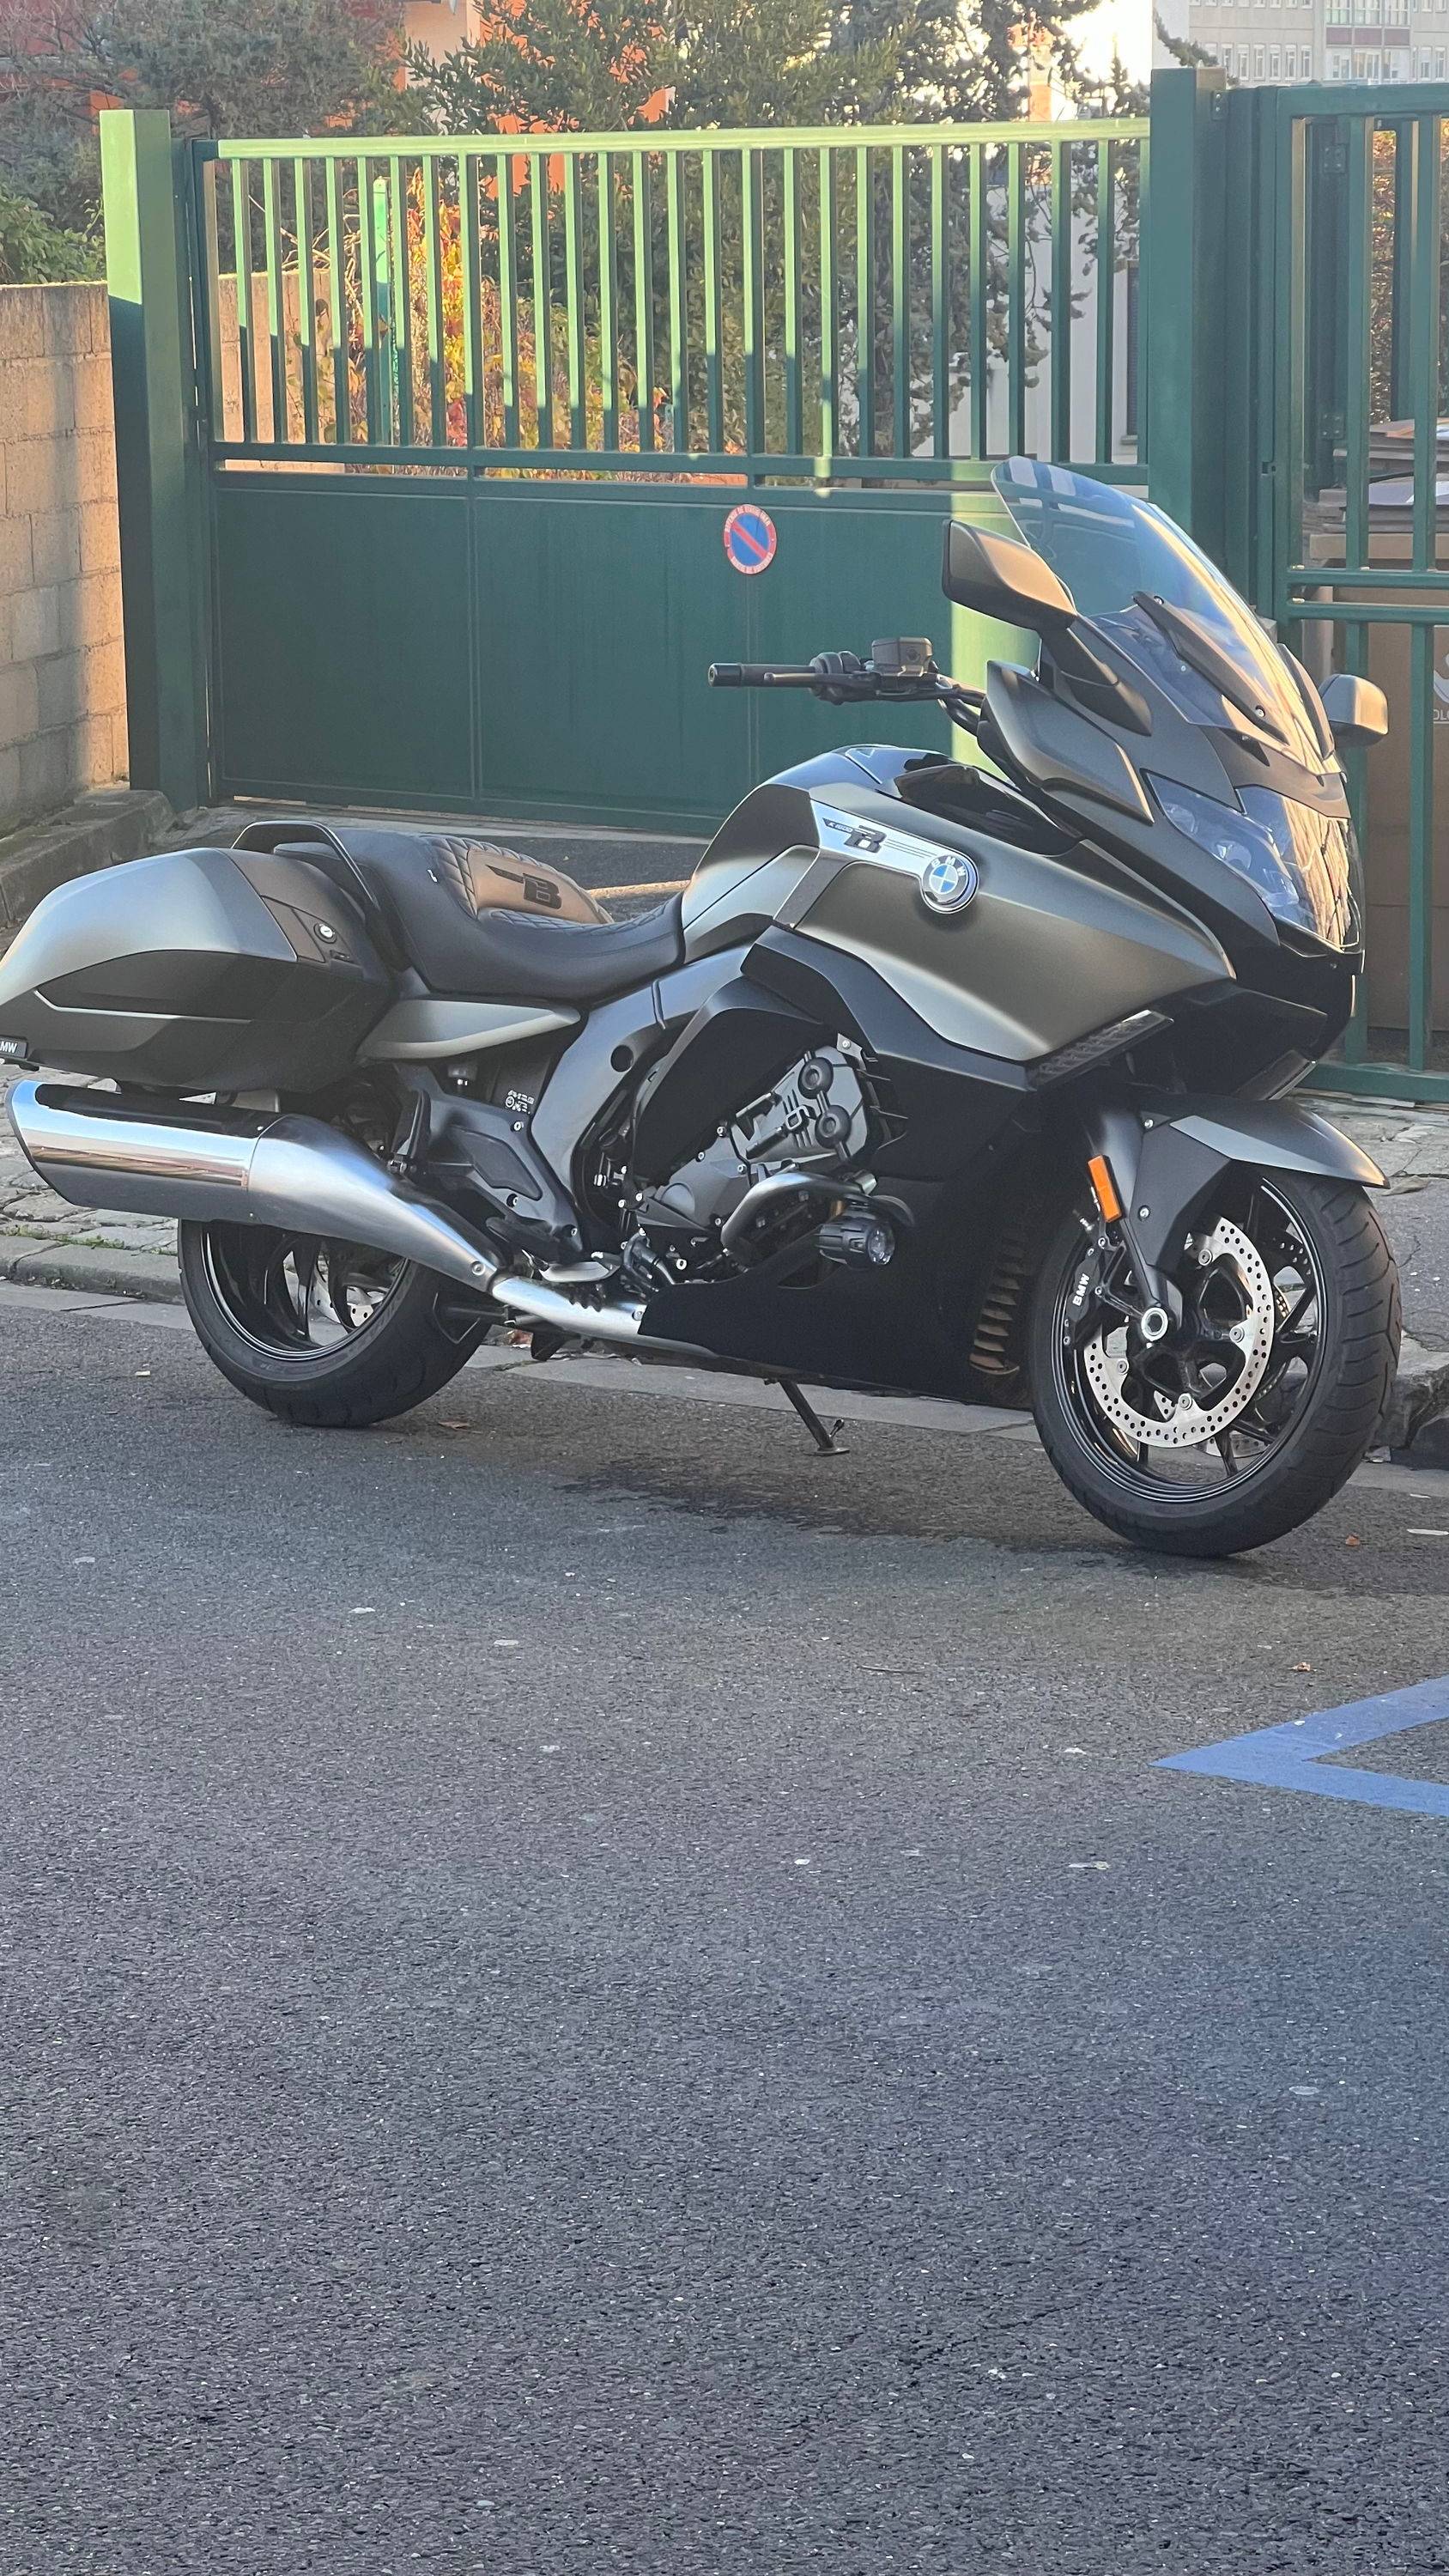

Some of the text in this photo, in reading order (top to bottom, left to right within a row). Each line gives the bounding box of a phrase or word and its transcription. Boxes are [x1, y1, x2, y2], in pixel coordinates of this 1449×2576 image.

[931, 856, 967, 877] BMW
[522, 872, 562, 910] B
[1072, 1273, 1090, 1306] BMW
